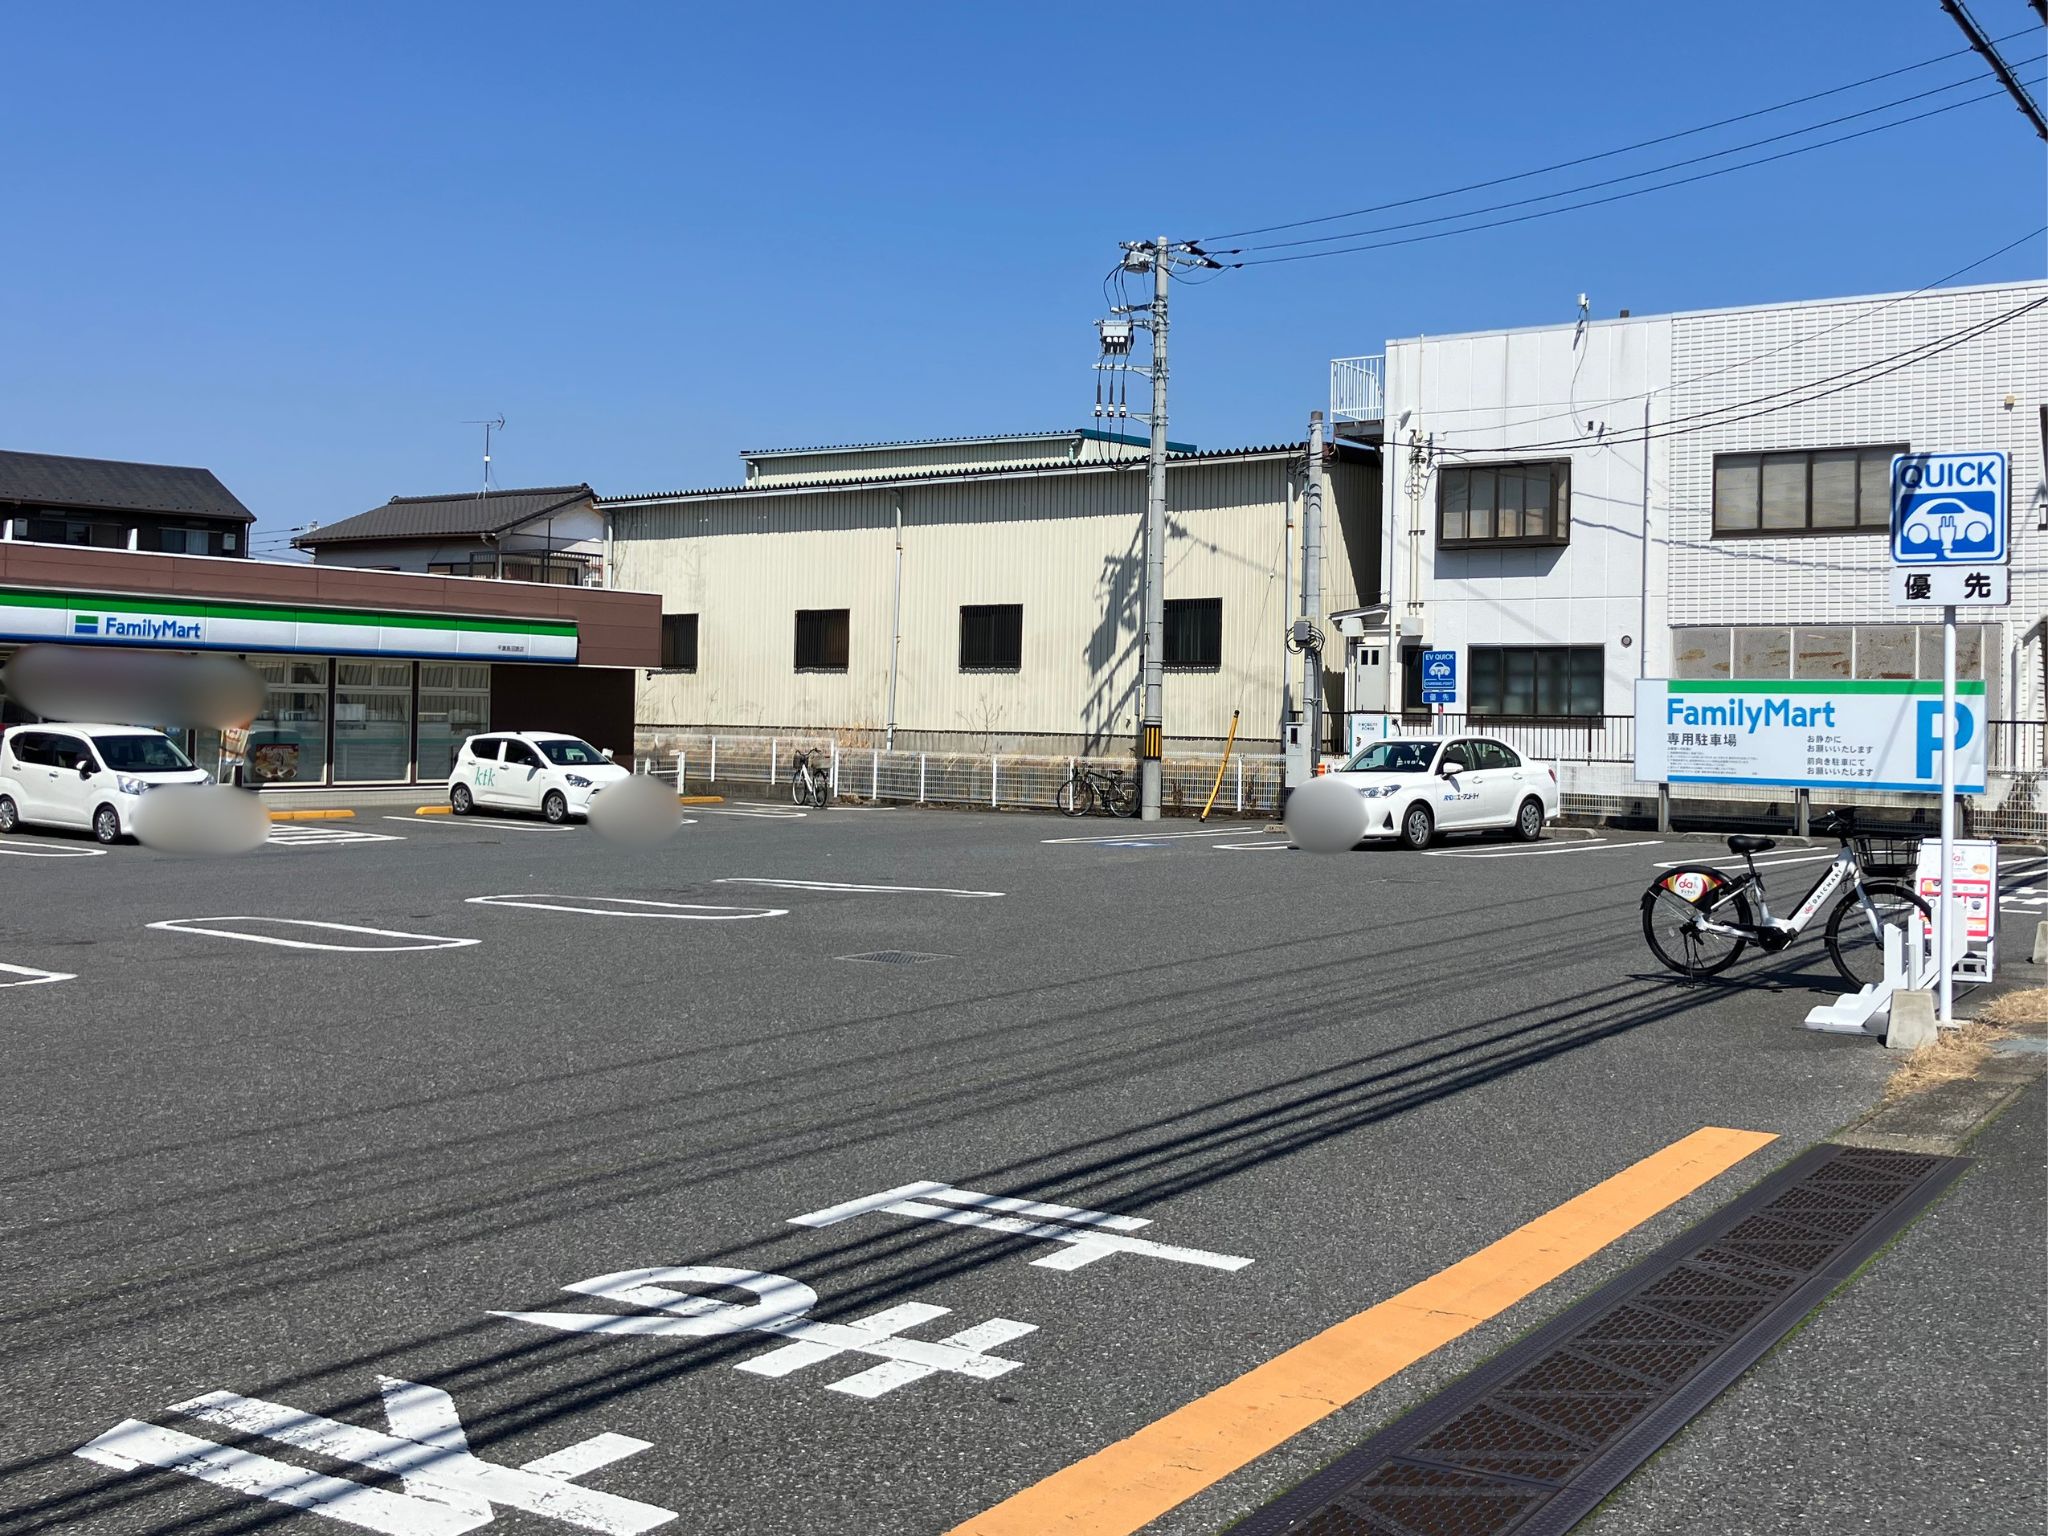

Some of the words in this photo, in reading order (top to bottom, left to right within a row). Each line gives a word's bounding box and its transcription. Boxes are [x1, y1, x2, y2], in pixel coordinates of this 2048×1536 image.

[1900, 461, 1997, 489] QUICK
[1904, 572, 1992, 600] 優先
[105, 617, 201, 639] FamilyMart
[1435, 653, 1454, 661] QUICK
[1667, 698, 1836, 734] FamilyMart
[1667, 732, 1737, 748] 専用駐車場
[1807, 735, 1842, 743] お静かに
[1916, 700, 1974, 779] P
[1807, 744, 1874, 754] お願いいたします
[1807, 757, 1866, 766] 前向き駐車にて
[474, 767, 496, 786] ktk
[1807, 767, 1874, 777] お願いいたします
[1812, 870, 1843, 905] DAICHARI
